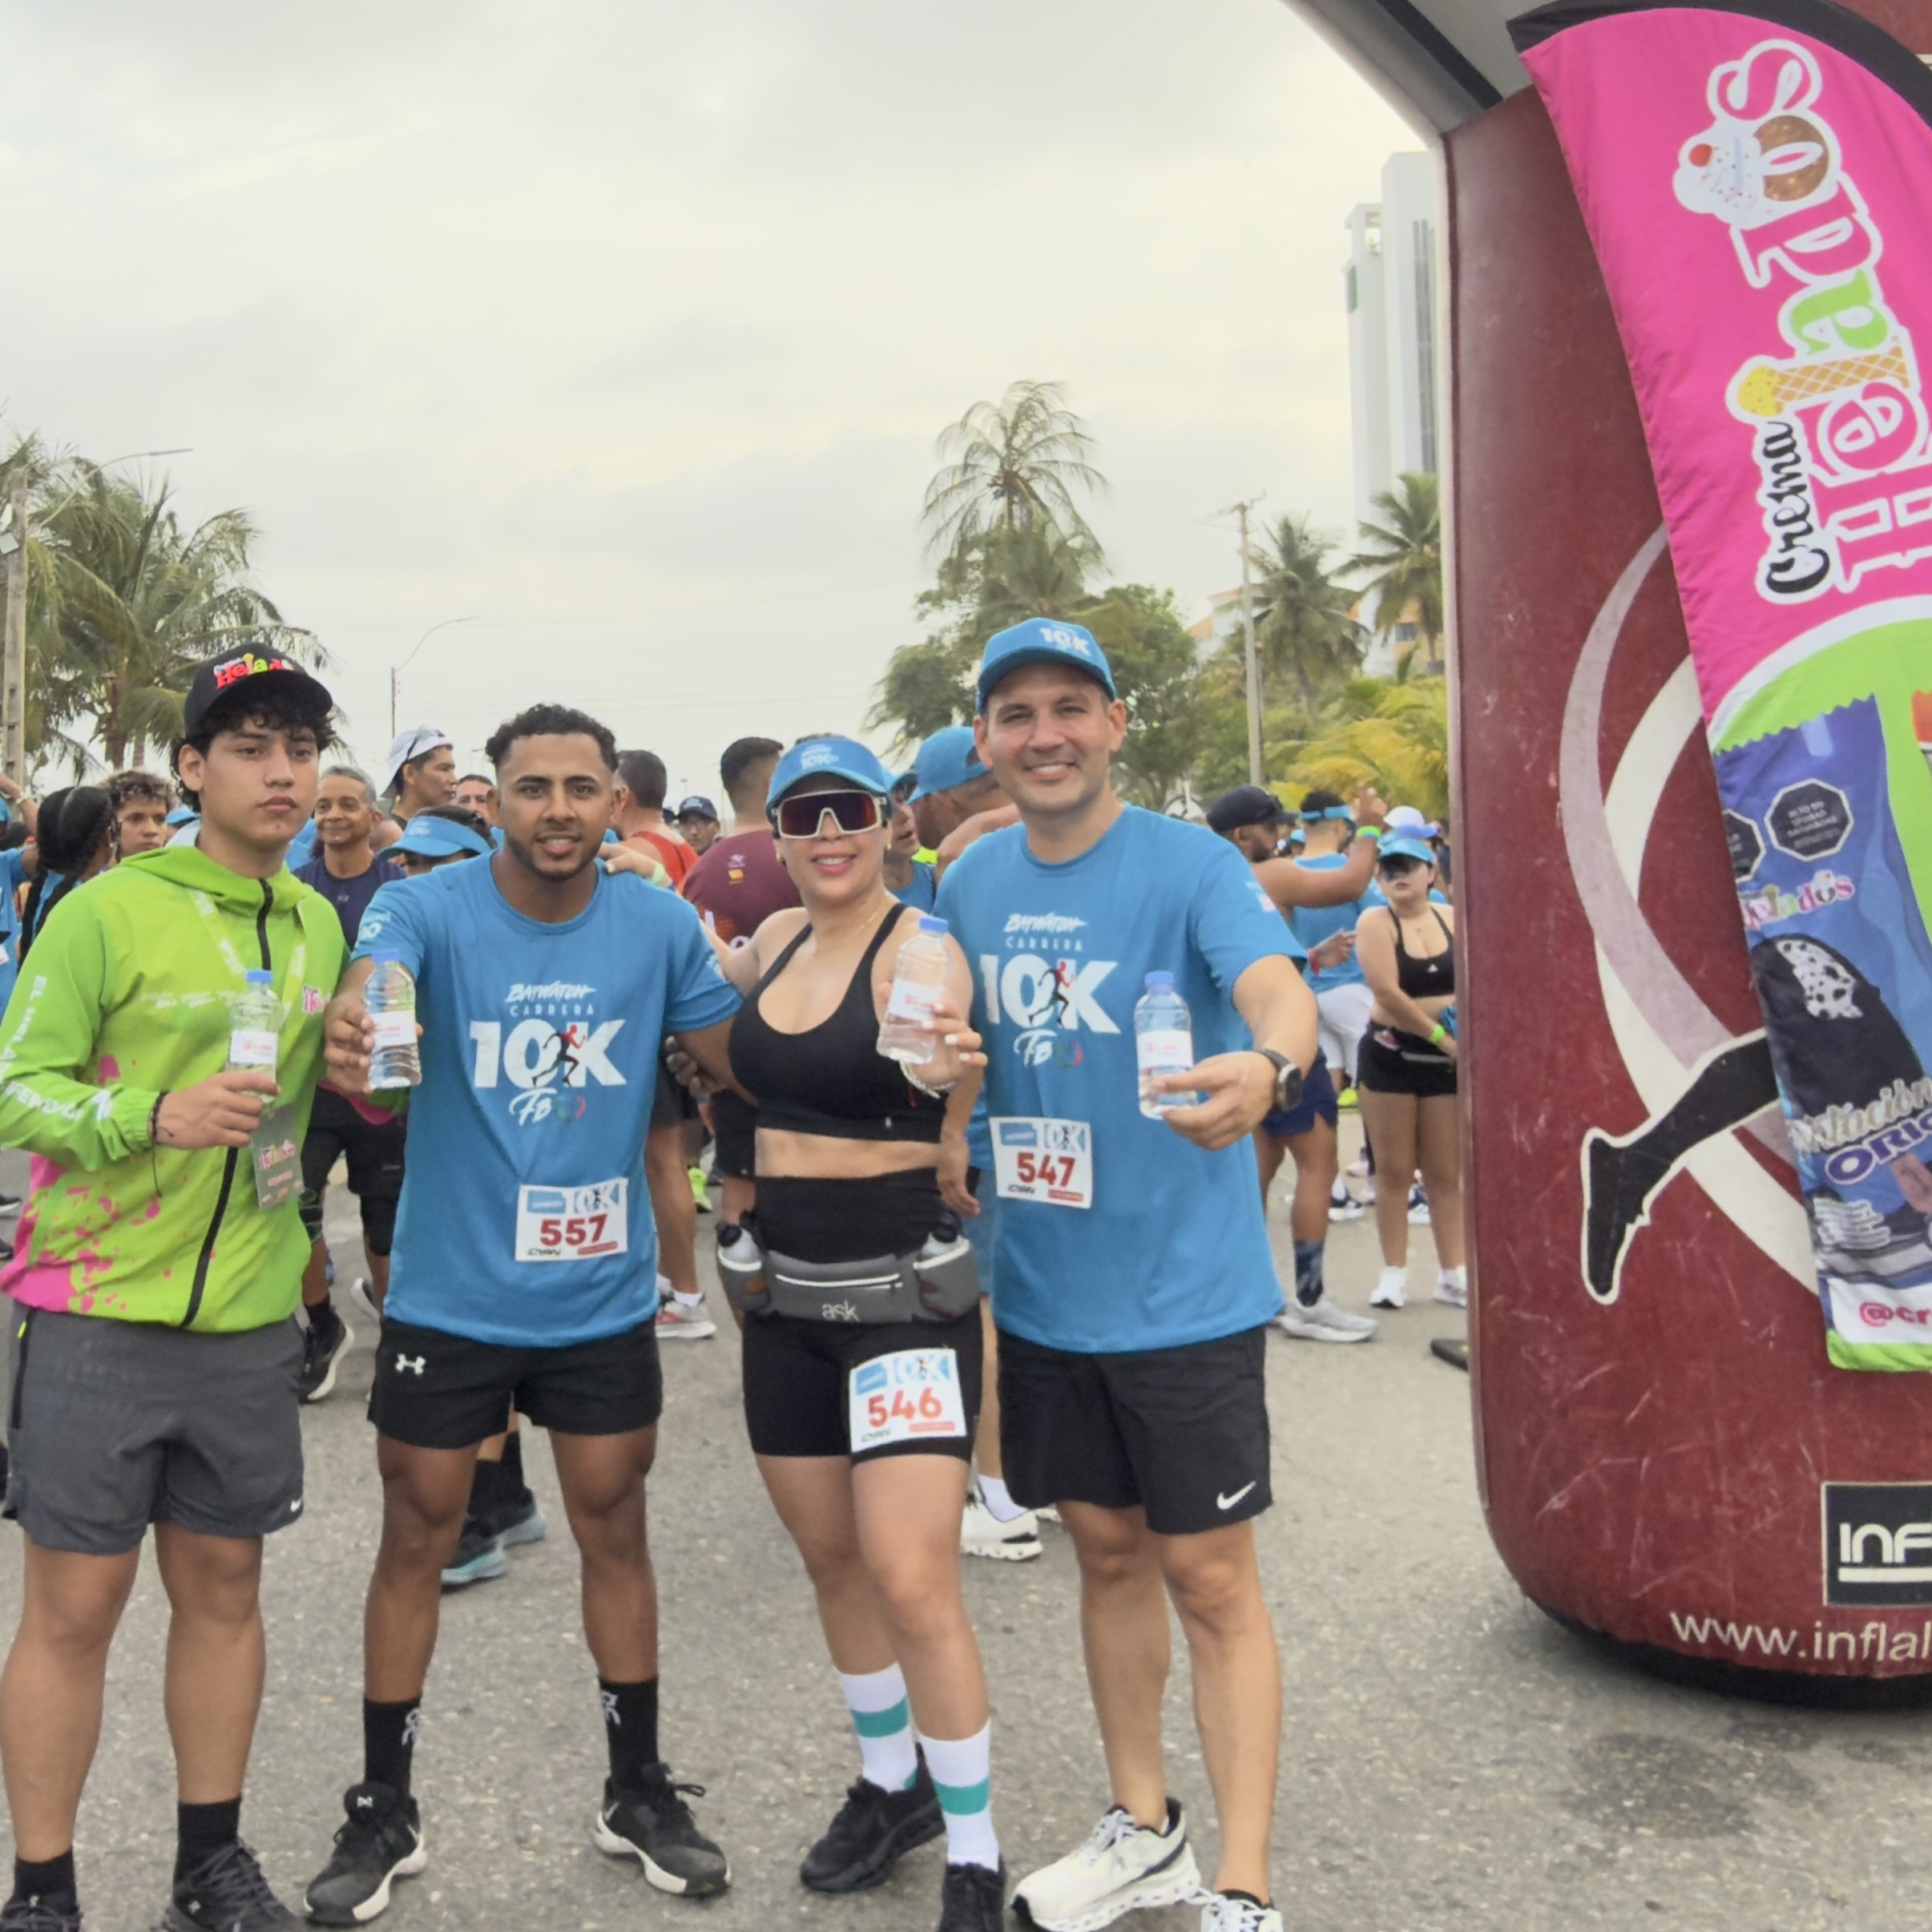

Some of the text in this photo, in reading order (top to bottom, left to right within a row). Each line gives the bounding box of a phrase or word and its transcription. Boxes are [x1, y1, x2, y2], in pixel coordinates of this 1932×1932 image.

[1681, 42, 1932, 590] Helados
[1762, 421, 1831, 594] Crema
[1006, 936, 1083, 952] CARRERA
[510, 1004, 595, 1018] CARRERA
[979, 953, 1122, 1035] 10K
[469, 1018, 627, 1089] 10K
[1017, 1152, 1075, 1187] 547
[539, 1213, 608, 1247] 557
[821, 1299, 861, 1322] ask
[868, 1387, 943, 1428] 546
